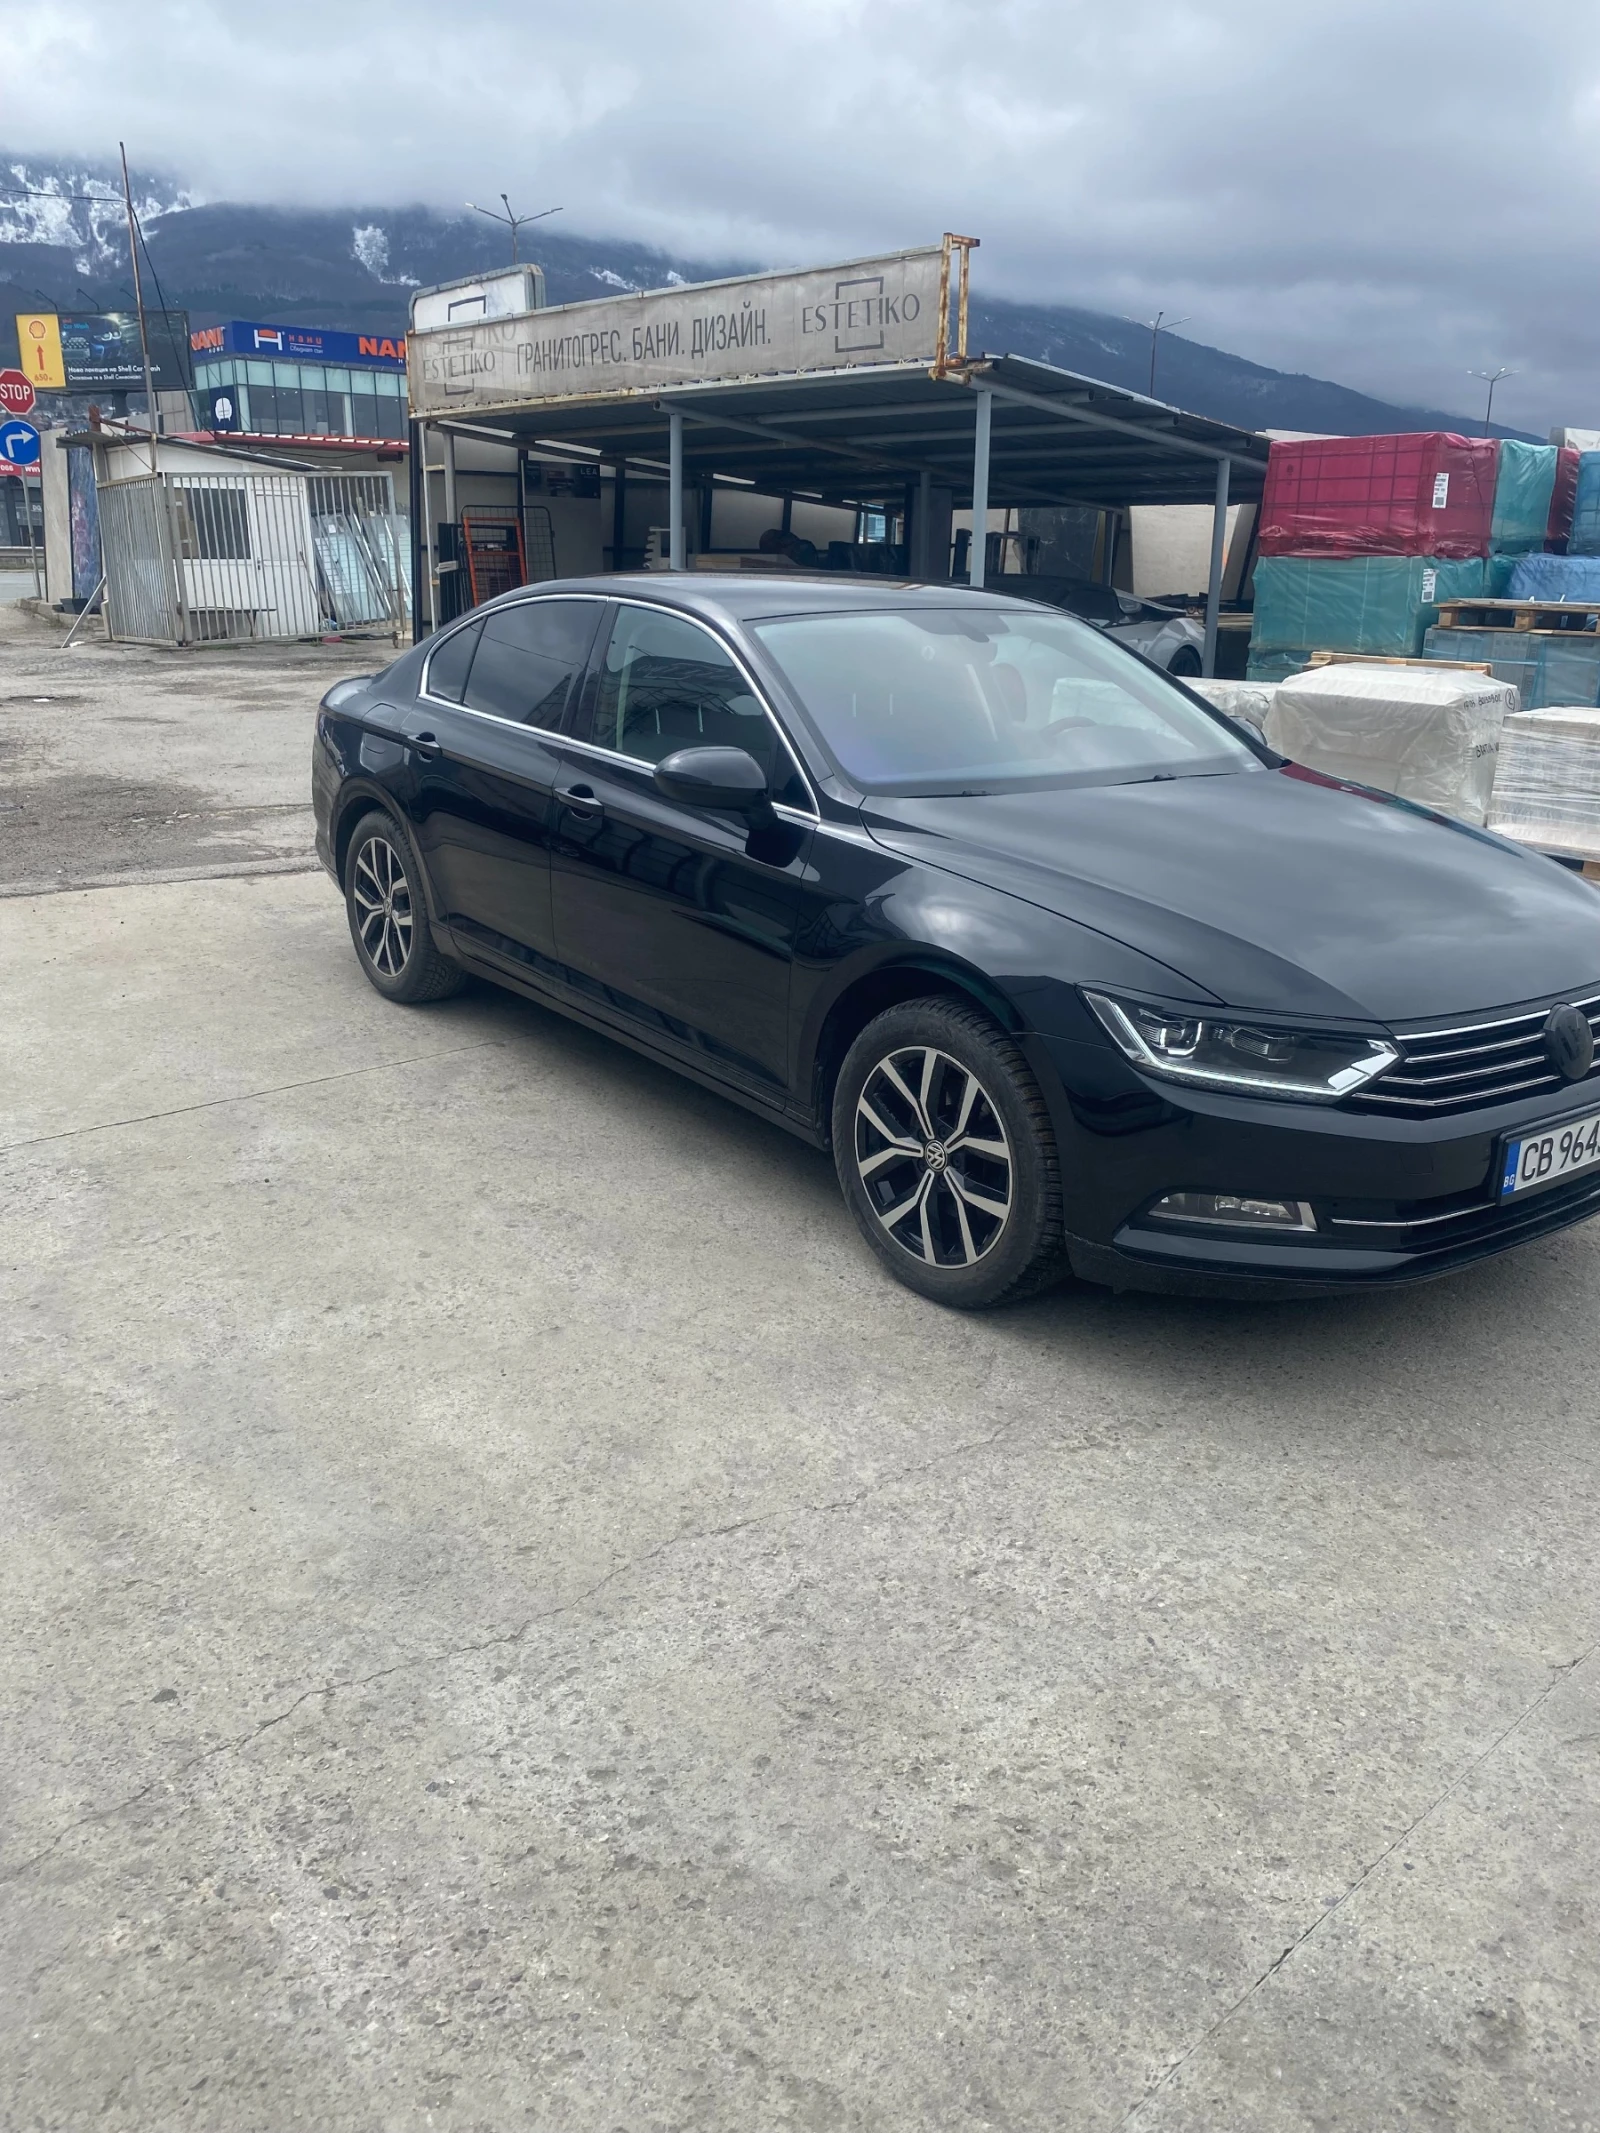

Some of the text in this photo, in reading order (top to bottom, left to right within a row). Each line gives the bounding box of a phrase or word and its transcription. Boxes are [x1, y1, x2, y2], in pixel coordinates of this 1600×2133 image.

[802, 294, 920, 334] ESTETIKO
[517, 301, 771, 374] ГРАНИТОГРЕС. БАНИ. ДИЗАЙН.
[423, 350, 496, 380] ESTETIKO
[0, 384, 31, 400] STOP
[1521, 1120, 1600, 1181] CB 964
[1503, 1174, 1515, 1188] BG
